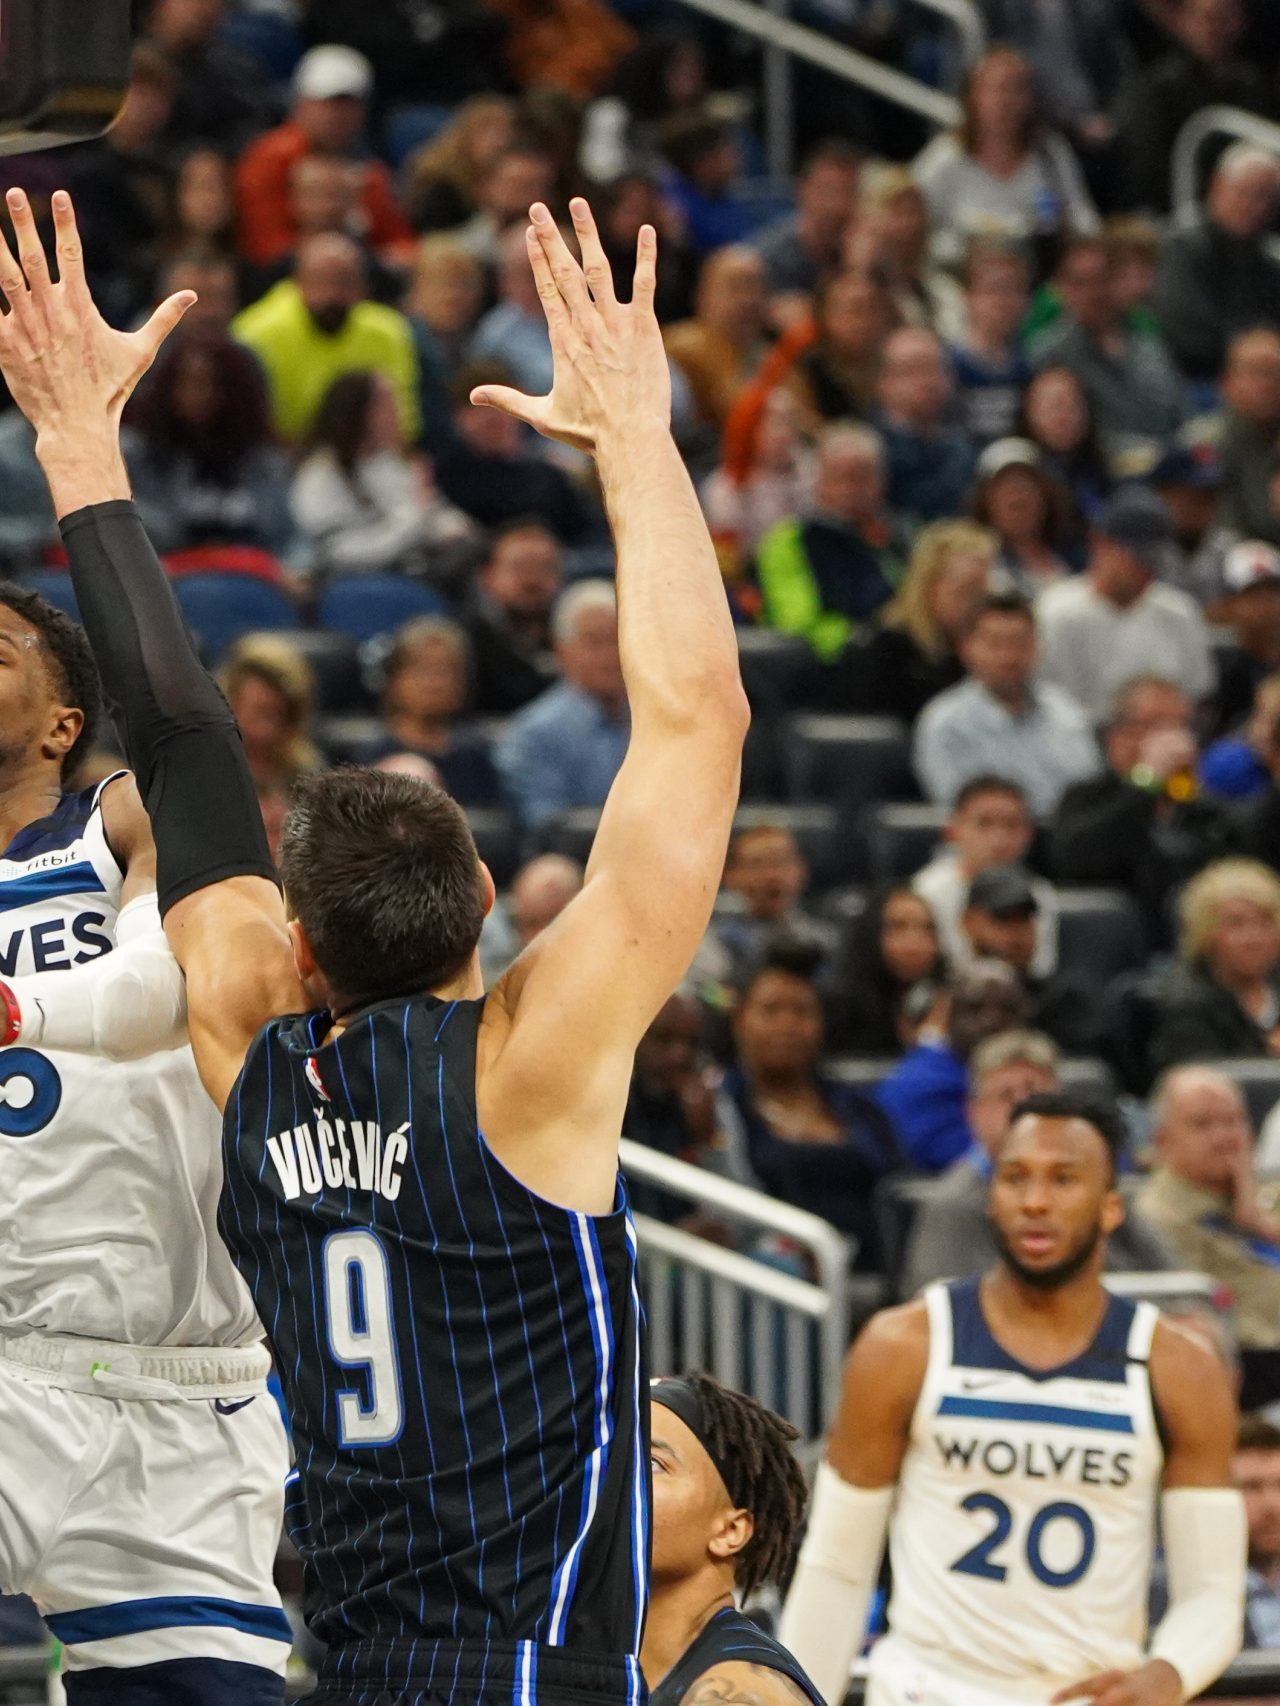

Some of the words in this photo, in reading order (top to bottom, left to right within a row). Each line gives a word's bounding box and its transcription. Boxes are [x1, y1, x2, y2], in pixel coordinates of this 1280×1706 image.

[266, 1106, 411, 1201] VUČEVIĆ
[321, 1225, 406, 1450] 9
[934, 1434, 1133, 1487] WOLVES
[950, 1489, 1095, 1588] 20
